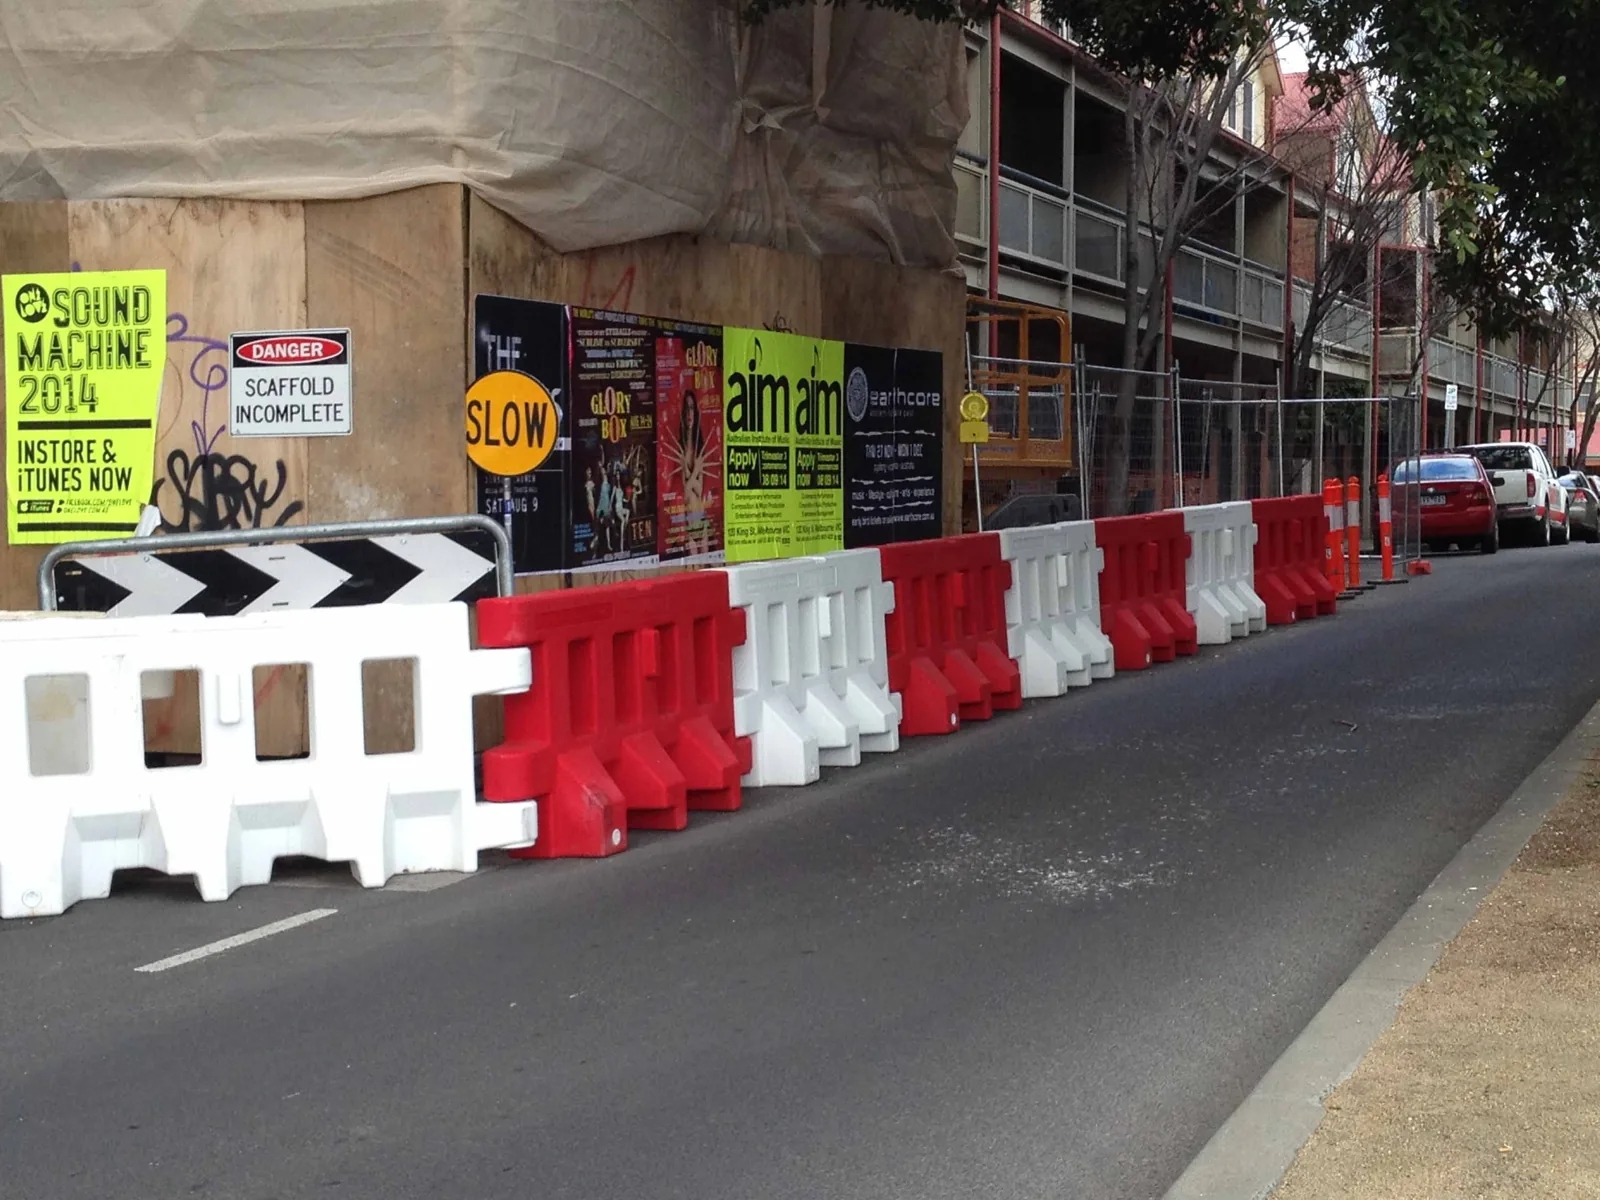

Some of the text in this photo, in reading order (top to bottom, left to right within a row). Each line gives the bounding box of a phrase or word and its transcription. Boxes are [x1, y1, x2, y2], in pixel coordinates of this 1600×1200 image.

[52, 286, 151, 327] SOUND
[18, 329, 152, 371] MACHINE
[252, 342, 323, 358] DANGER
[485, 334, 522, 371] THE
[686, 340, 718, 367] GLORY
[19, 374, 98, 414] 2014
[245, 377, 334, 397] SCAFFOLD
[726, 358, 790, 433] aim
[795, 364, 842, 435] aim
[870, 387, 941, 406] earthcore
[236, 403, 344, 423] INCOMPLETE
[591, 386, 631, 415] GLORY
[466, 400, 549, 449] SLOW
[601, 415, 628, 443] BOX
[18, 438, 117, 464] INSTORE &
[729, 448, 757, 470] Apply
[797, 450, 815, 471] Apply
[18, 467, 132, 492] iTUNES NOW
[729, 473, 750, 486] now
[797, 474, 811, 486] now
[486, 497, 503, 514] SAT
[532, 496, 538, 512] 9
[631, 519, 652, 541] TEN
